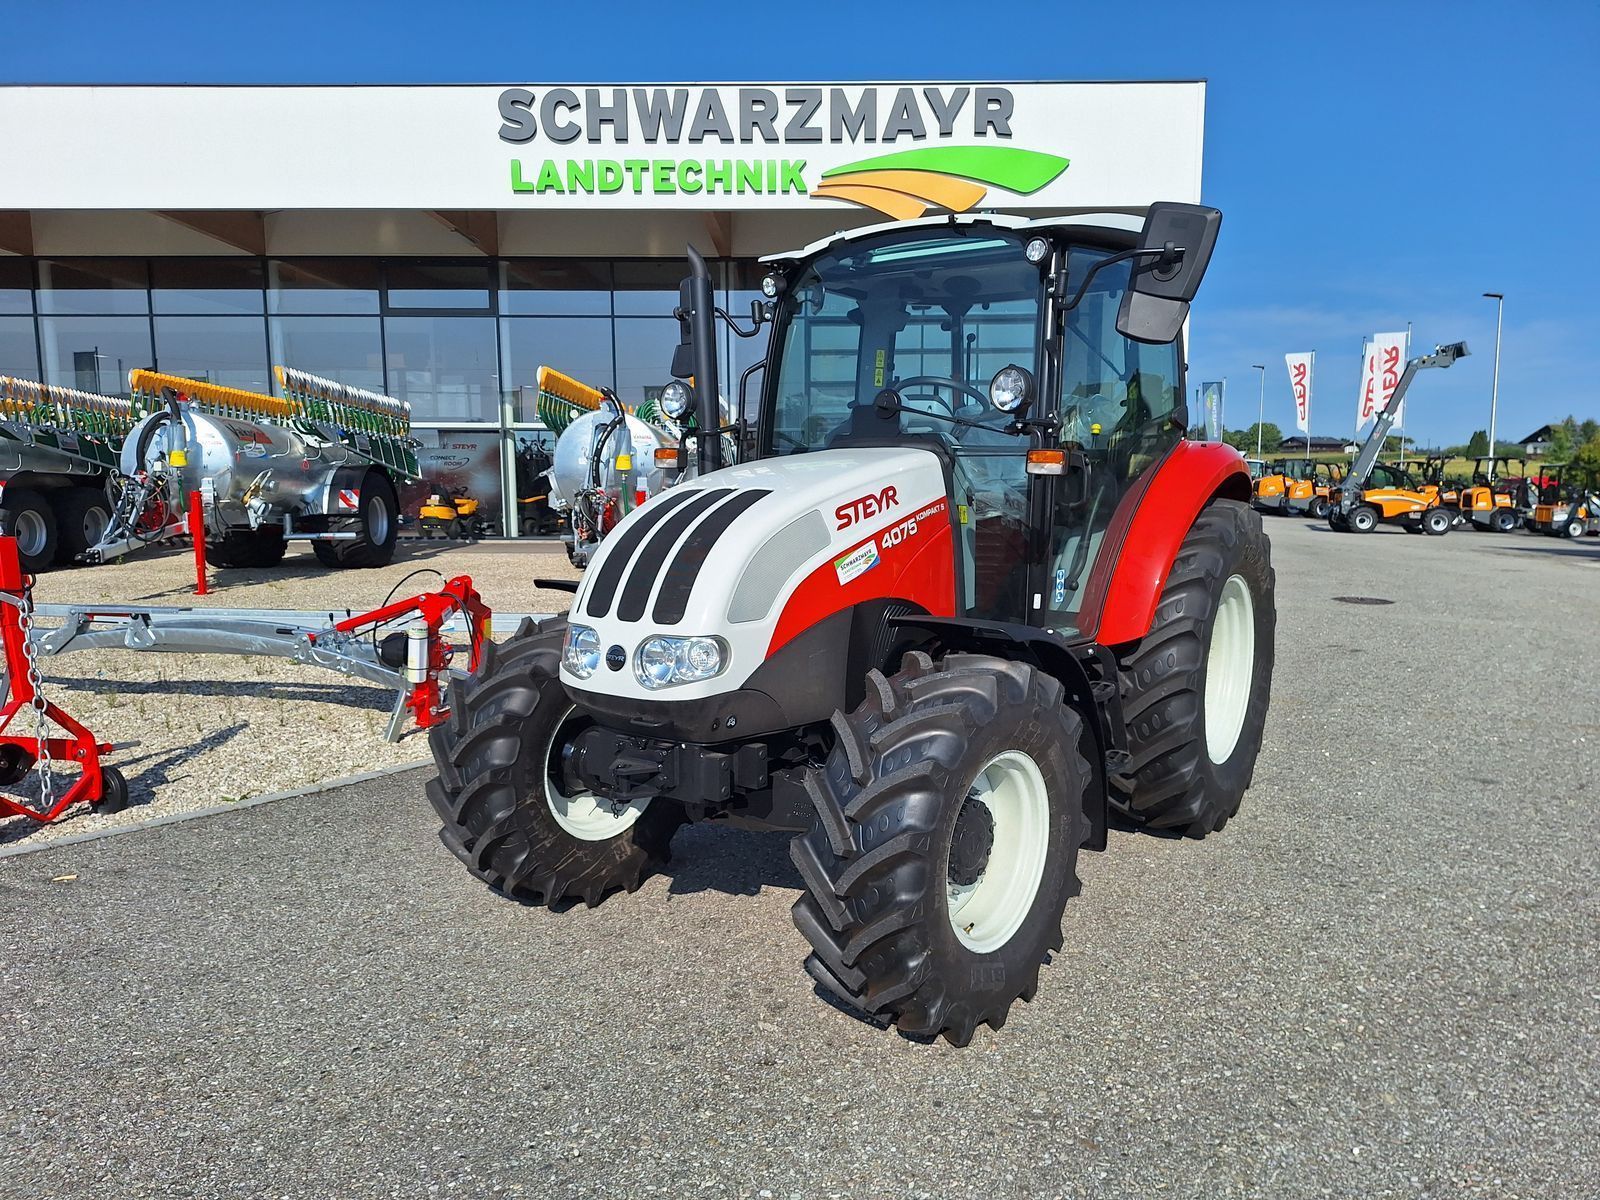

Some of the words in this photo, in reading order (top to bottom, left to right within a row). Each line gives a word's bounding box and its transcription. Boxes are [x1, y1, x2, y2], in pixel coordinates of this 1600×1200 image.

[497, 87, 1015, 144] SCHWARZMAYR
[510, 159, 808, 195] LANDTECHNIK
[1293, 363, 1307, 421] STEYR
[1383, 346, 1400, 410] EYR
[835, 485, 899, 531] STEYR
[881, 520, 918, 549] 4075
[915, 504, 940, 522] KOMPAKT
[840, 548, 872, 571] SCHWARZMAYR
